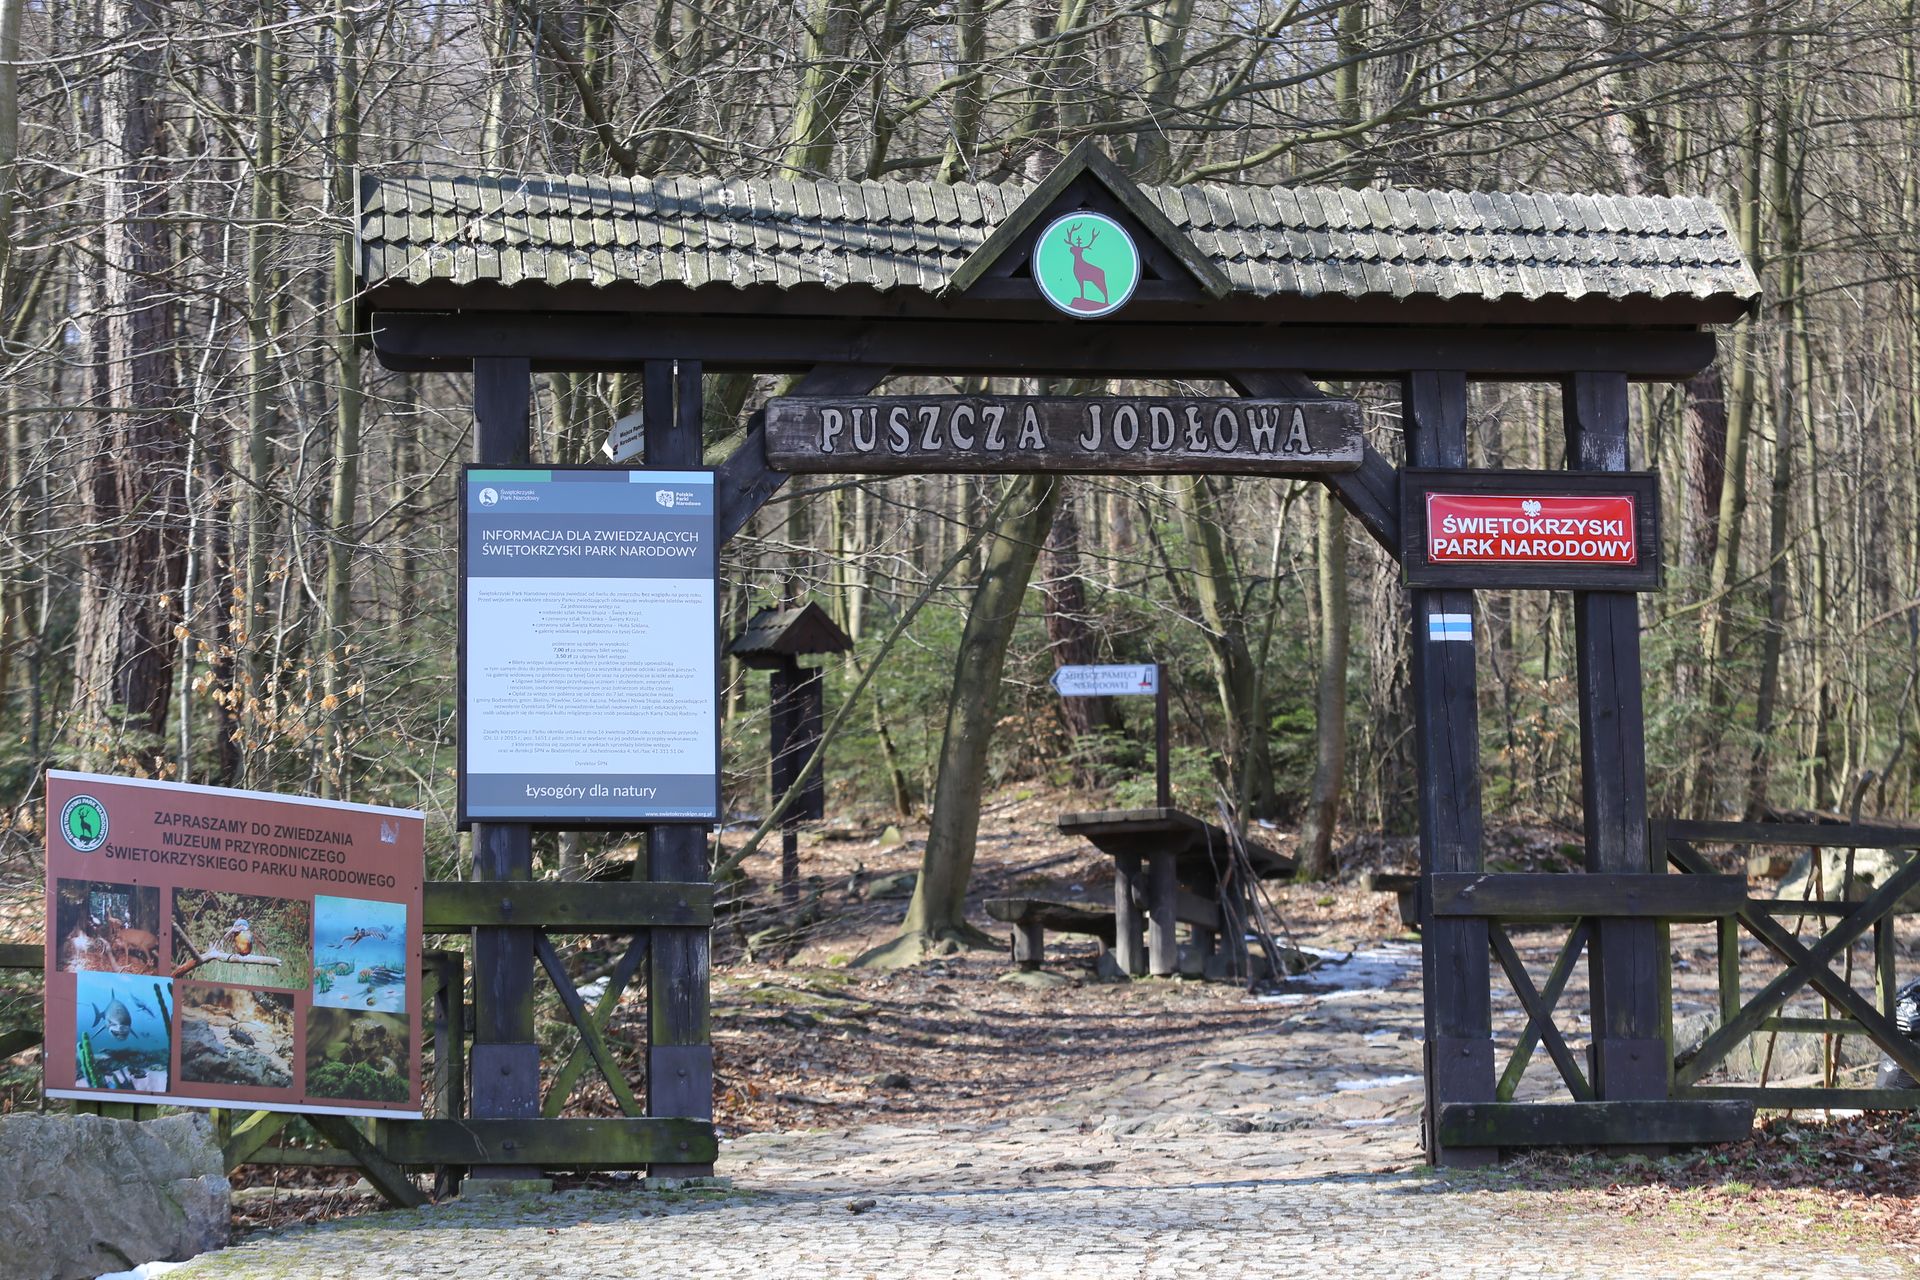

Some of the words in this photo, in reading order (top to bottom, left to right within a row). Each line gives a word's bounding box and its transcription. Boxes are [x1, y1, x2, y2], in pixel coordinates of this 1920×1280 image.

[820, 404, 1046, 453] PUSZCZA
[1080, 404, 1312, 454] JODŁOWA
[482, 530, 563, 541] INFORMACJA
[567, 530, 591, 541] DLA
[595, 531, 698, 544] ZWIEDZAJĄCYCH
[1442, 514, 1623, 538] ŚWIĘTOKRZYSKI
[482, 544, 581, 558] ŚWIĘTOKRZYSKI
[585, 546, 617, 556] PARK
[620, 546, 697, 557] NARODOWY
[1434, 539, 1494, 555] PARK
[1501, 539, 1631, 557] NARODOWY
[526, 784, 585, 799] Łysogóry
[590, 784, 609, 797] dla
[614, 786, 656, 799] natury
[154, 812, 246, 834] ZAPRASZAMY
[252, 822, 270, 836] DO
[274, 824, 353, 846] ZWIEDZANIA
[162, 831, 221, 850] MUZEUM
[225, 840, 346, 864] PRZYRODNICZEGO
[252, 860, 297, 877] PARKU
[301, 866, 396, 888] NARODOWEGO
